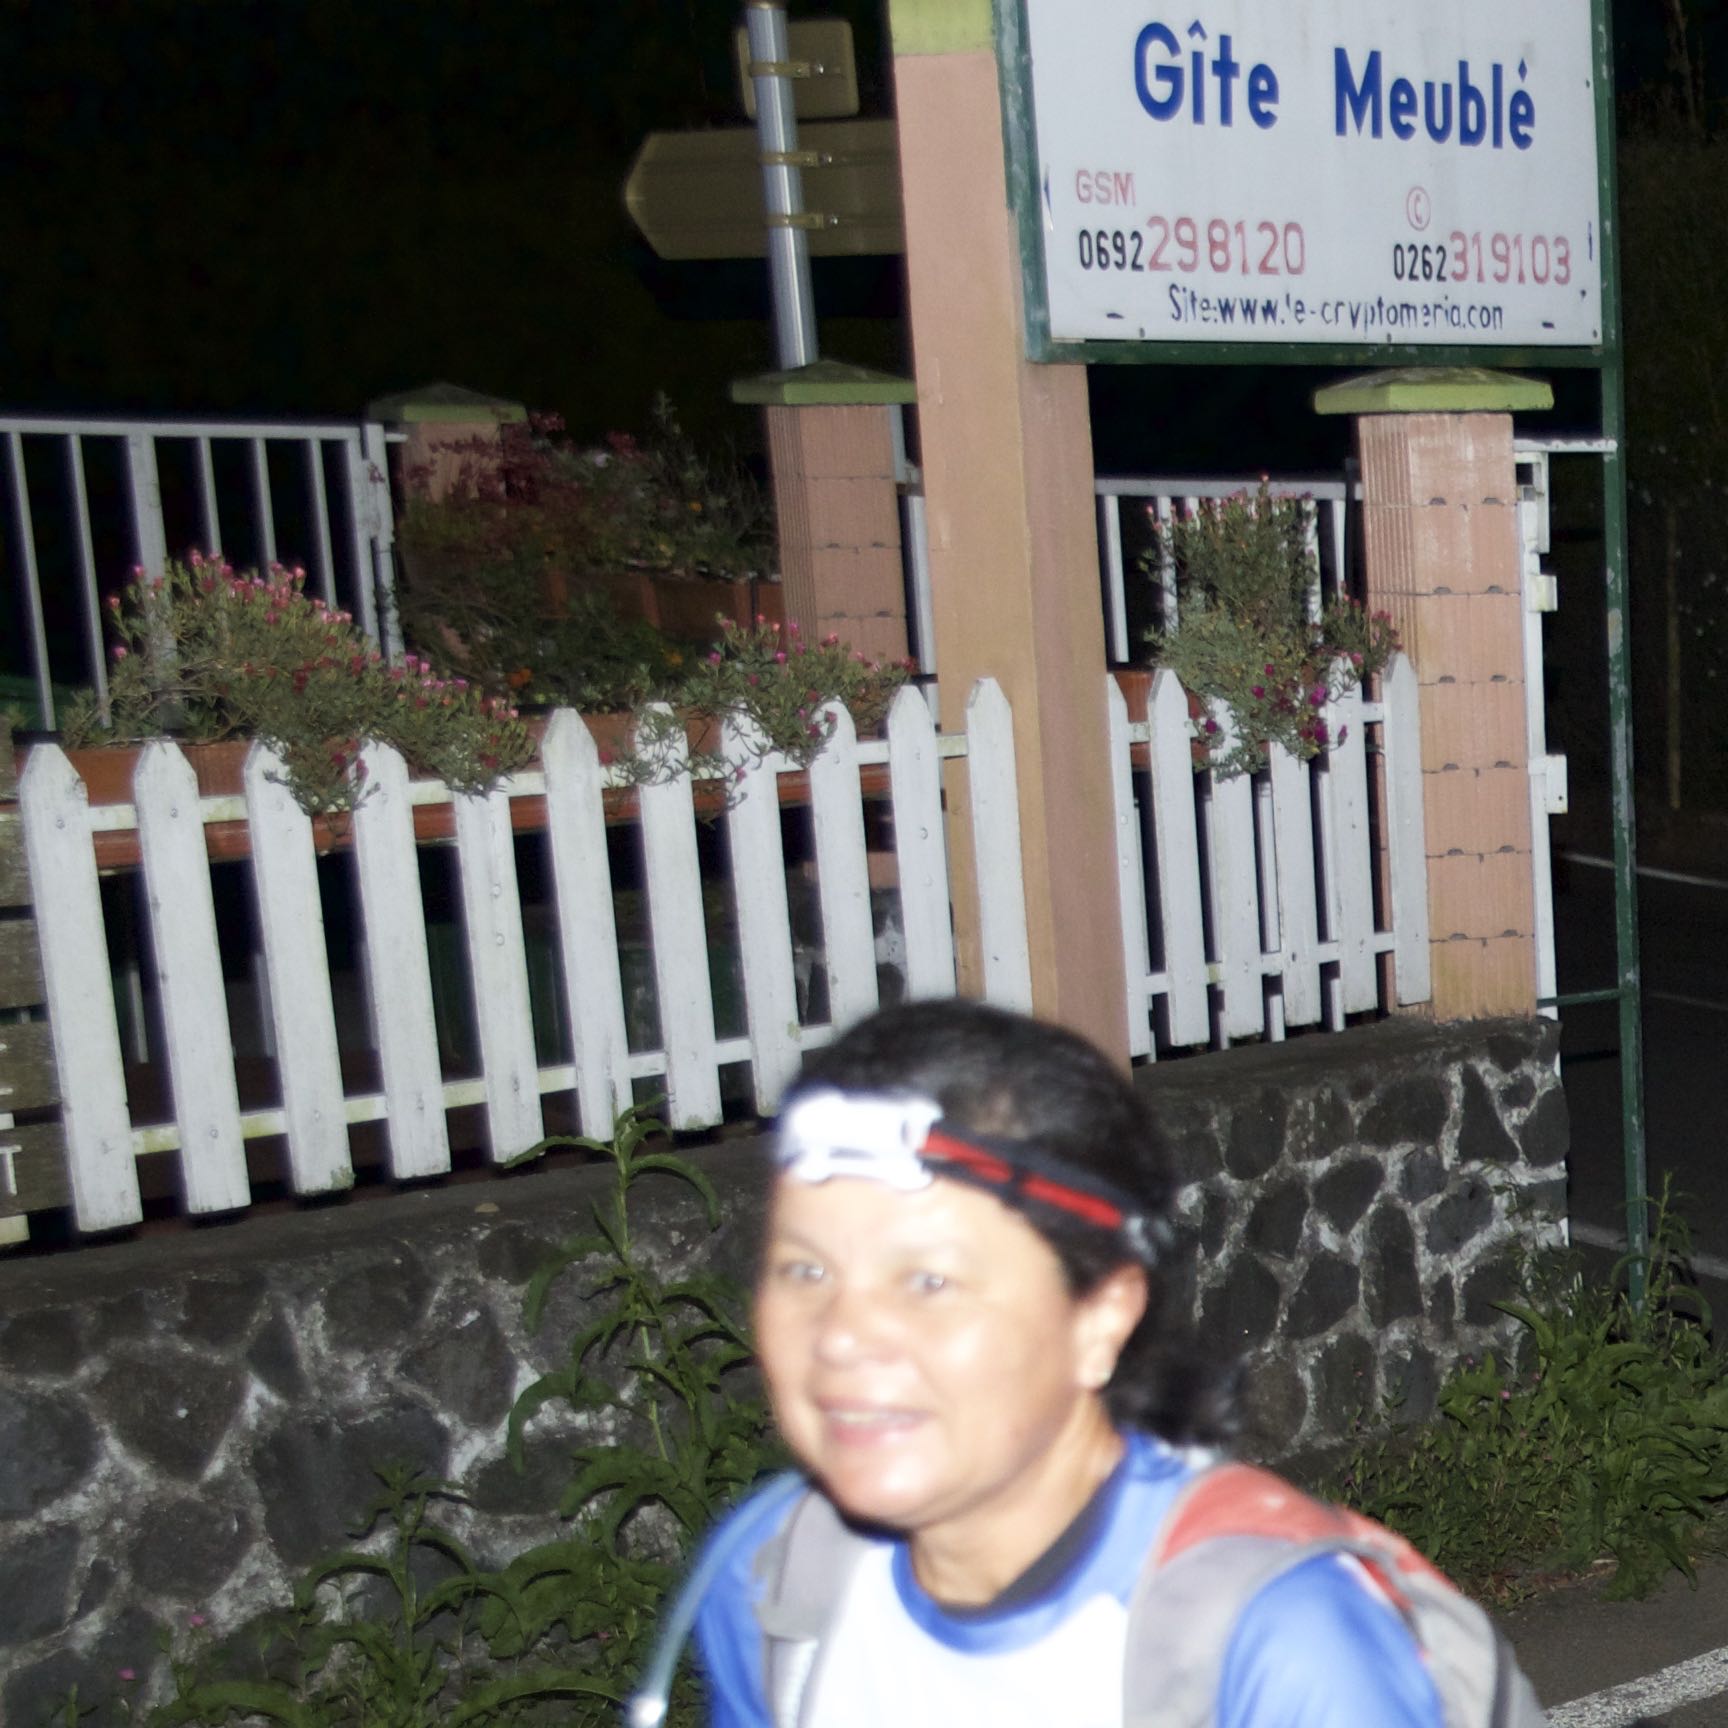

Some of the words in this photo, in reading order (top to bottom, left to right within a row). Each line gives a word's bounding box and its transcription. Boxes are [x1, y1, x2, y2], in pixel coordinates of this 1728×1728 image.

[1134, 20, 1280, 130] Gîte
[1333, 46, 1536, 151] Meublé
[1075, 169, 1137, 208] GSM
